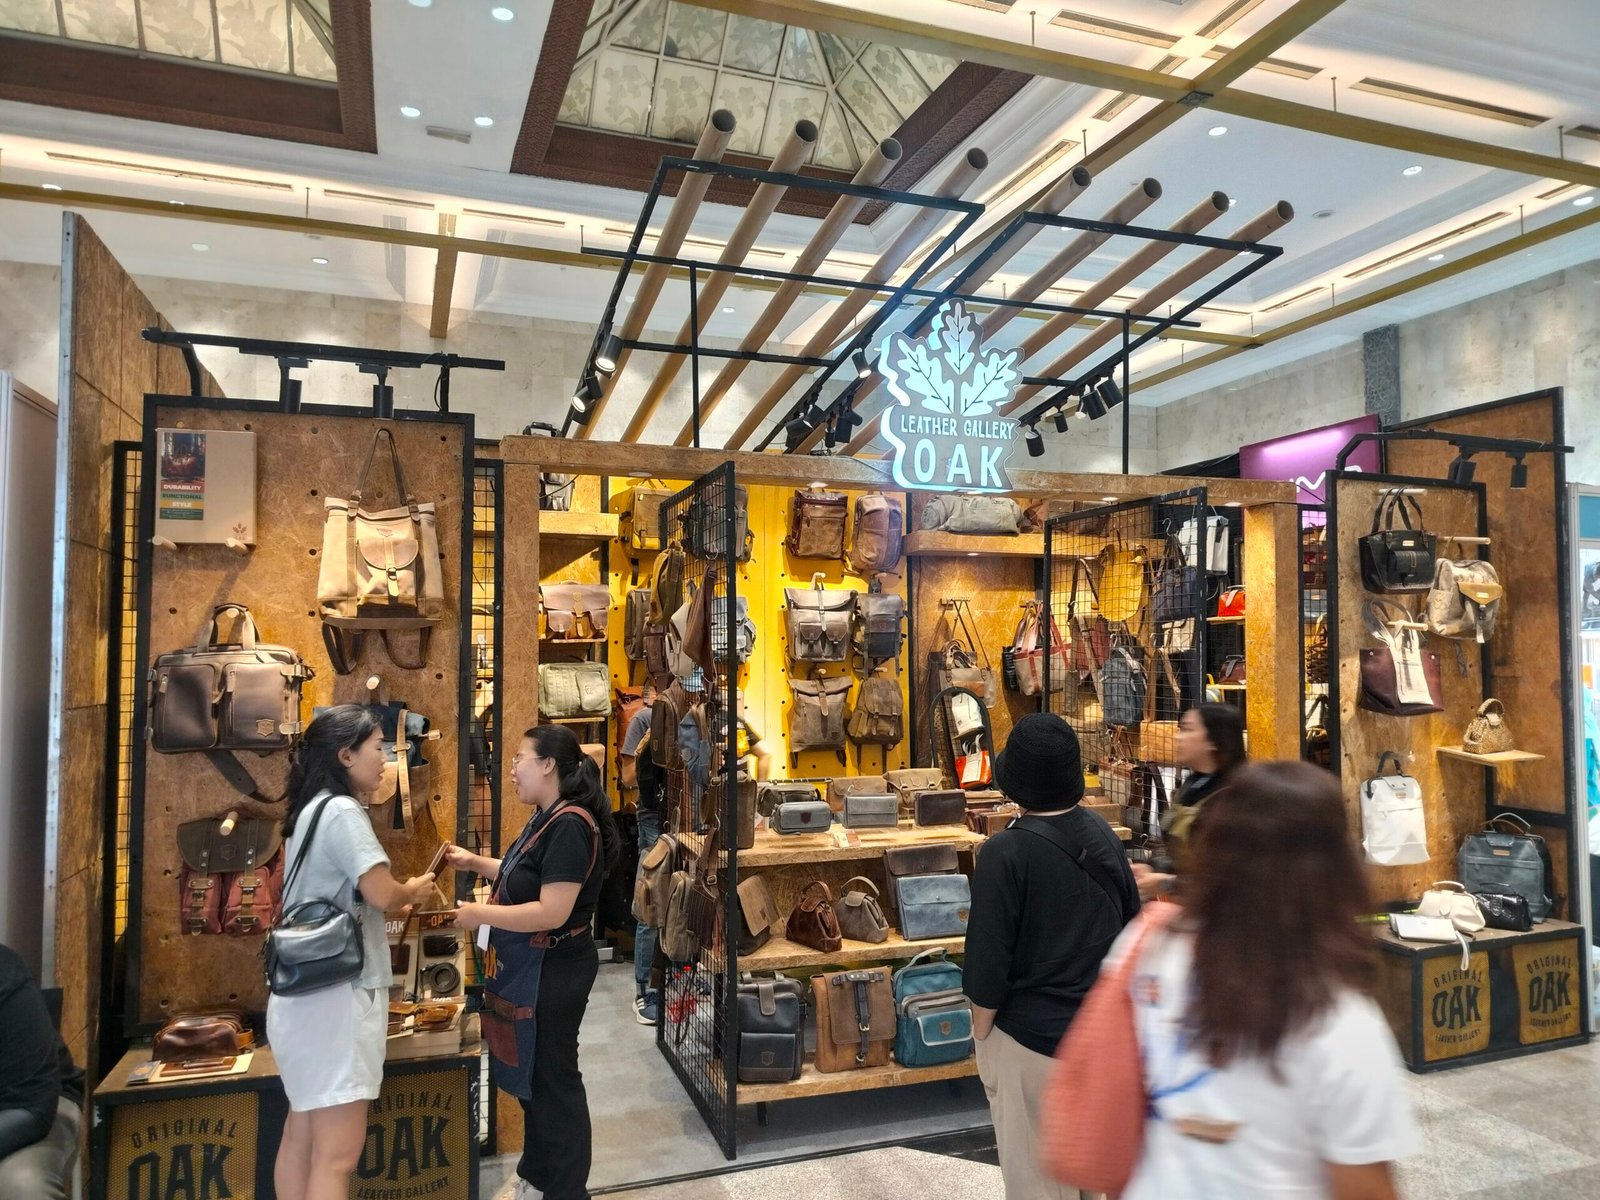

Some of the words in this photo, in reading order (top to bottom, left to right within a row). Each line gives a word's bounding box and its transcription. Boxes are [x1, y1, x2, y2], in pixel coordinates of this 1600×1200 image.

[901, 414, 958, 437] LEATHER
[963, 419, 1015, 440] GALLERY
[914, 438, 1003, 488] OAK
[1527, 954, 1572, 974] ORIGINAL
[1433, 970, 1482, 988] ORIGINAL
[1529, 971, 1572, 1014] OAK
[1432, 985, 1482, 1029] OAK
[373, 1091, 453, 1114] RIGINAL
[132, 1117, 238, 1149] ORIGINAL
[357, 1115, 450, 1180] OAK
[406, 1175, 449, 1198] GALLERY
